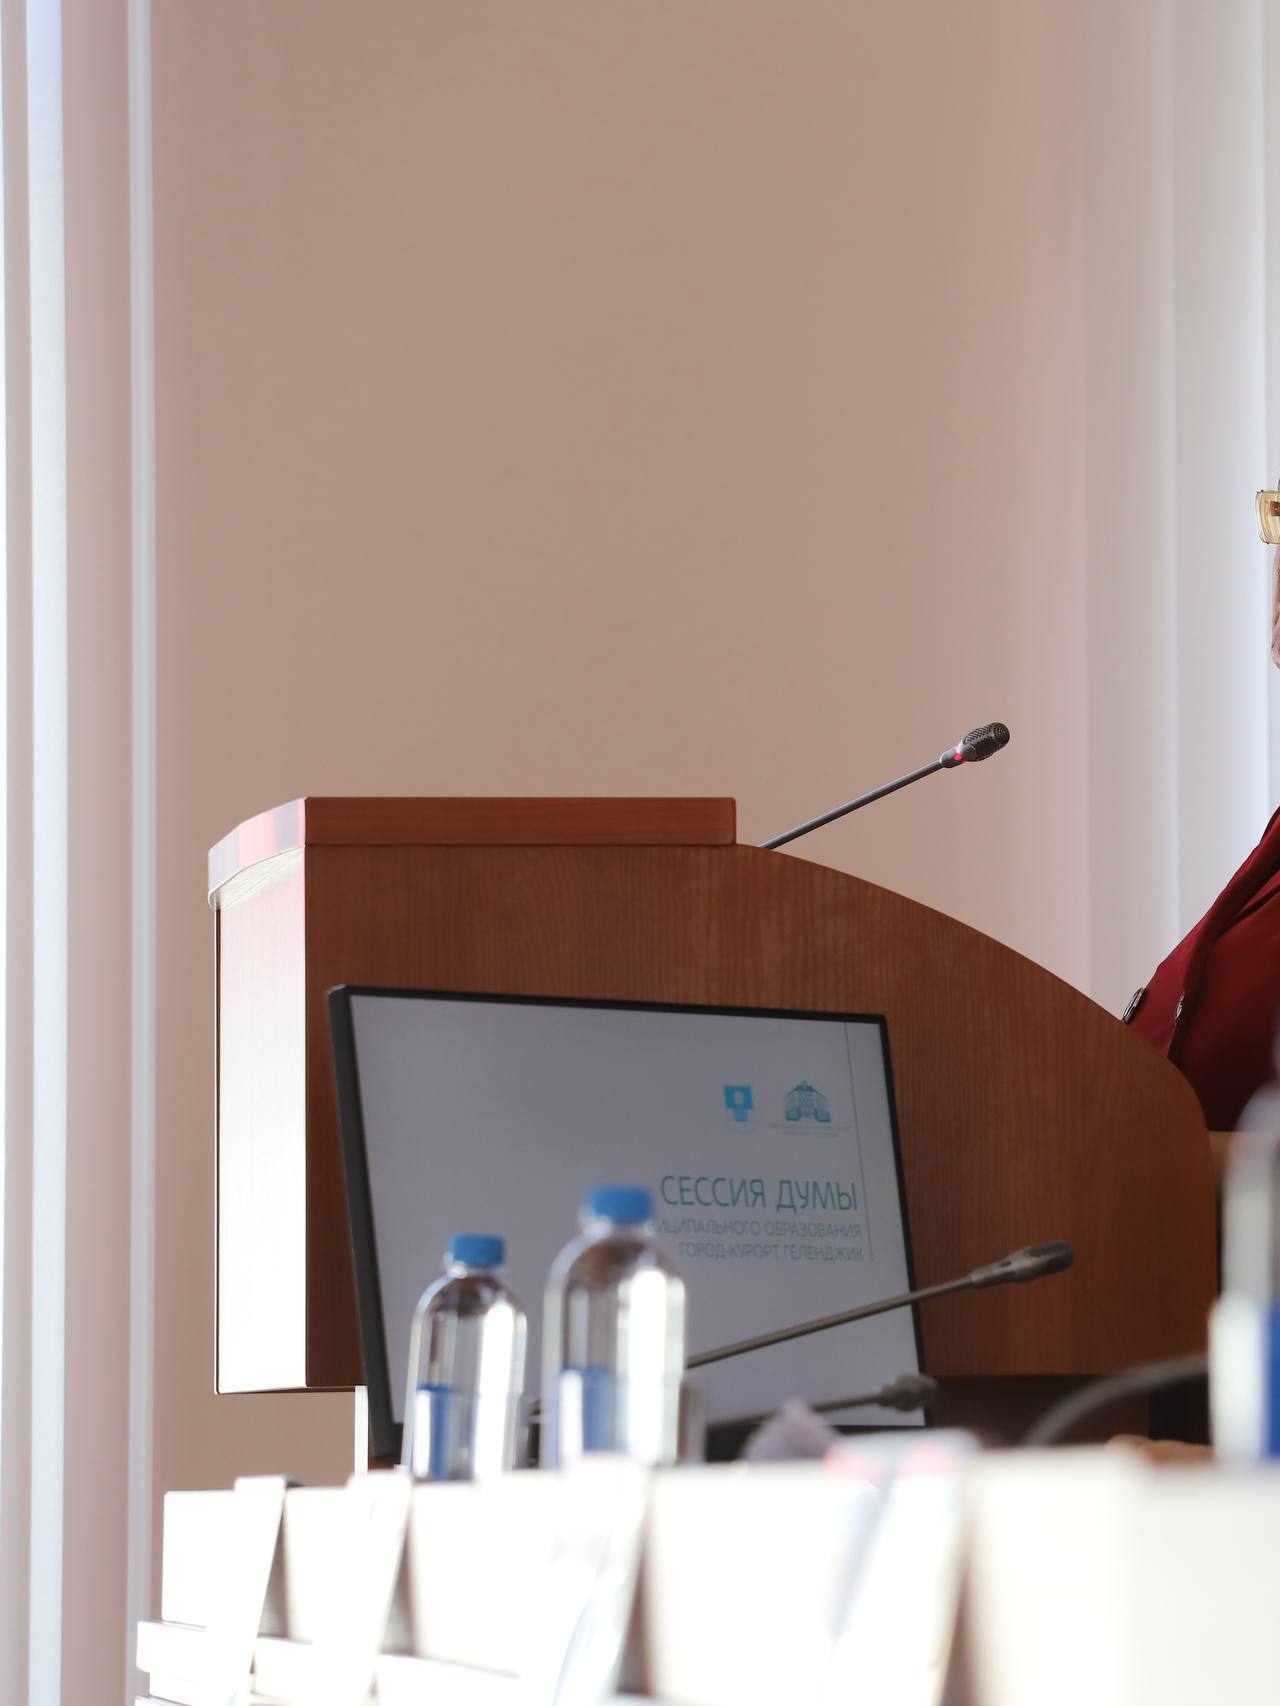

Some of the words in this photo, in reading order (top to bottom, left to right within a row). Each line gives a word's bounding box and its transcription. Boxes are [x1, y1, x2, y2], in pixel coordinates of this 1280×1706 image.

[660, 1175, 767, 1208] СЕССИЯ
[776, 1179, 858, 1214] ДУМЫ
[656, 1218, 761, 1236] ИЦИПАЛЬНОГО
[763, 1220, 862, 1238] ОБРАЗОВАНИЯ
[782, 1244, 864, 1263] ГЕЛЕНДЖИК
